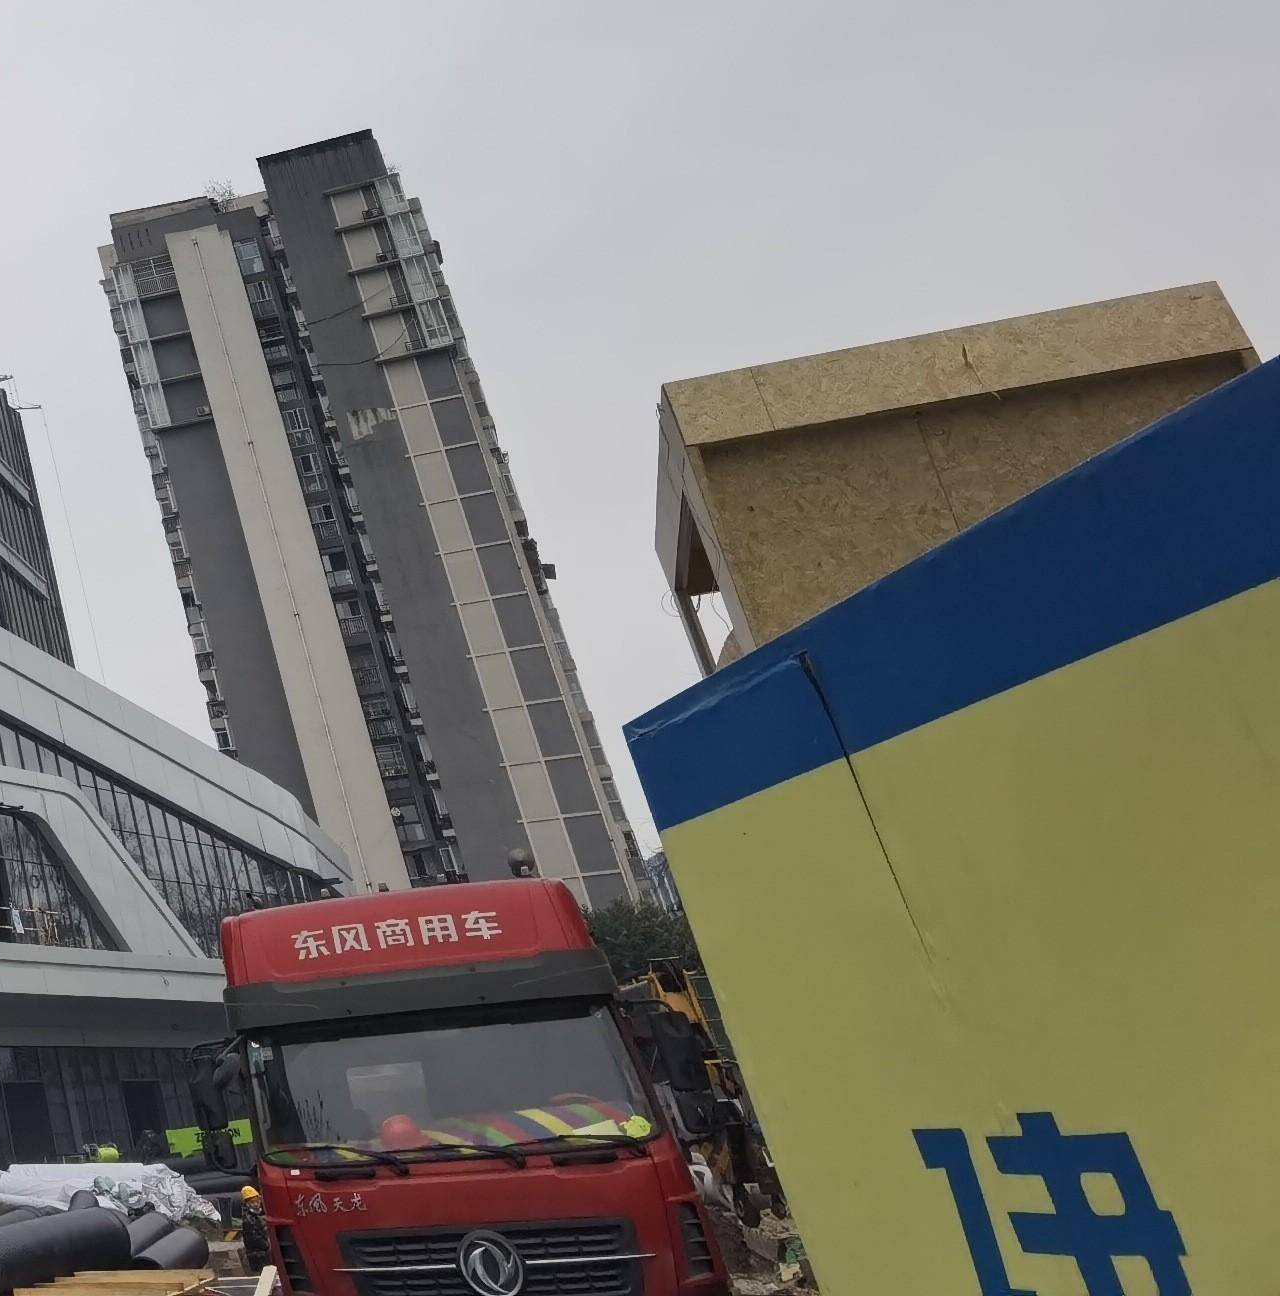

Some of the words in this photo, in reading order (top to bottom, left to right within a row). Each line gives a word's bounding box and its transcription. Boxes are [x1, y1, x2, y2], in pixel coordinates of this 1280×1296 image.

[290, 910, 503, 961] 东风商用车
